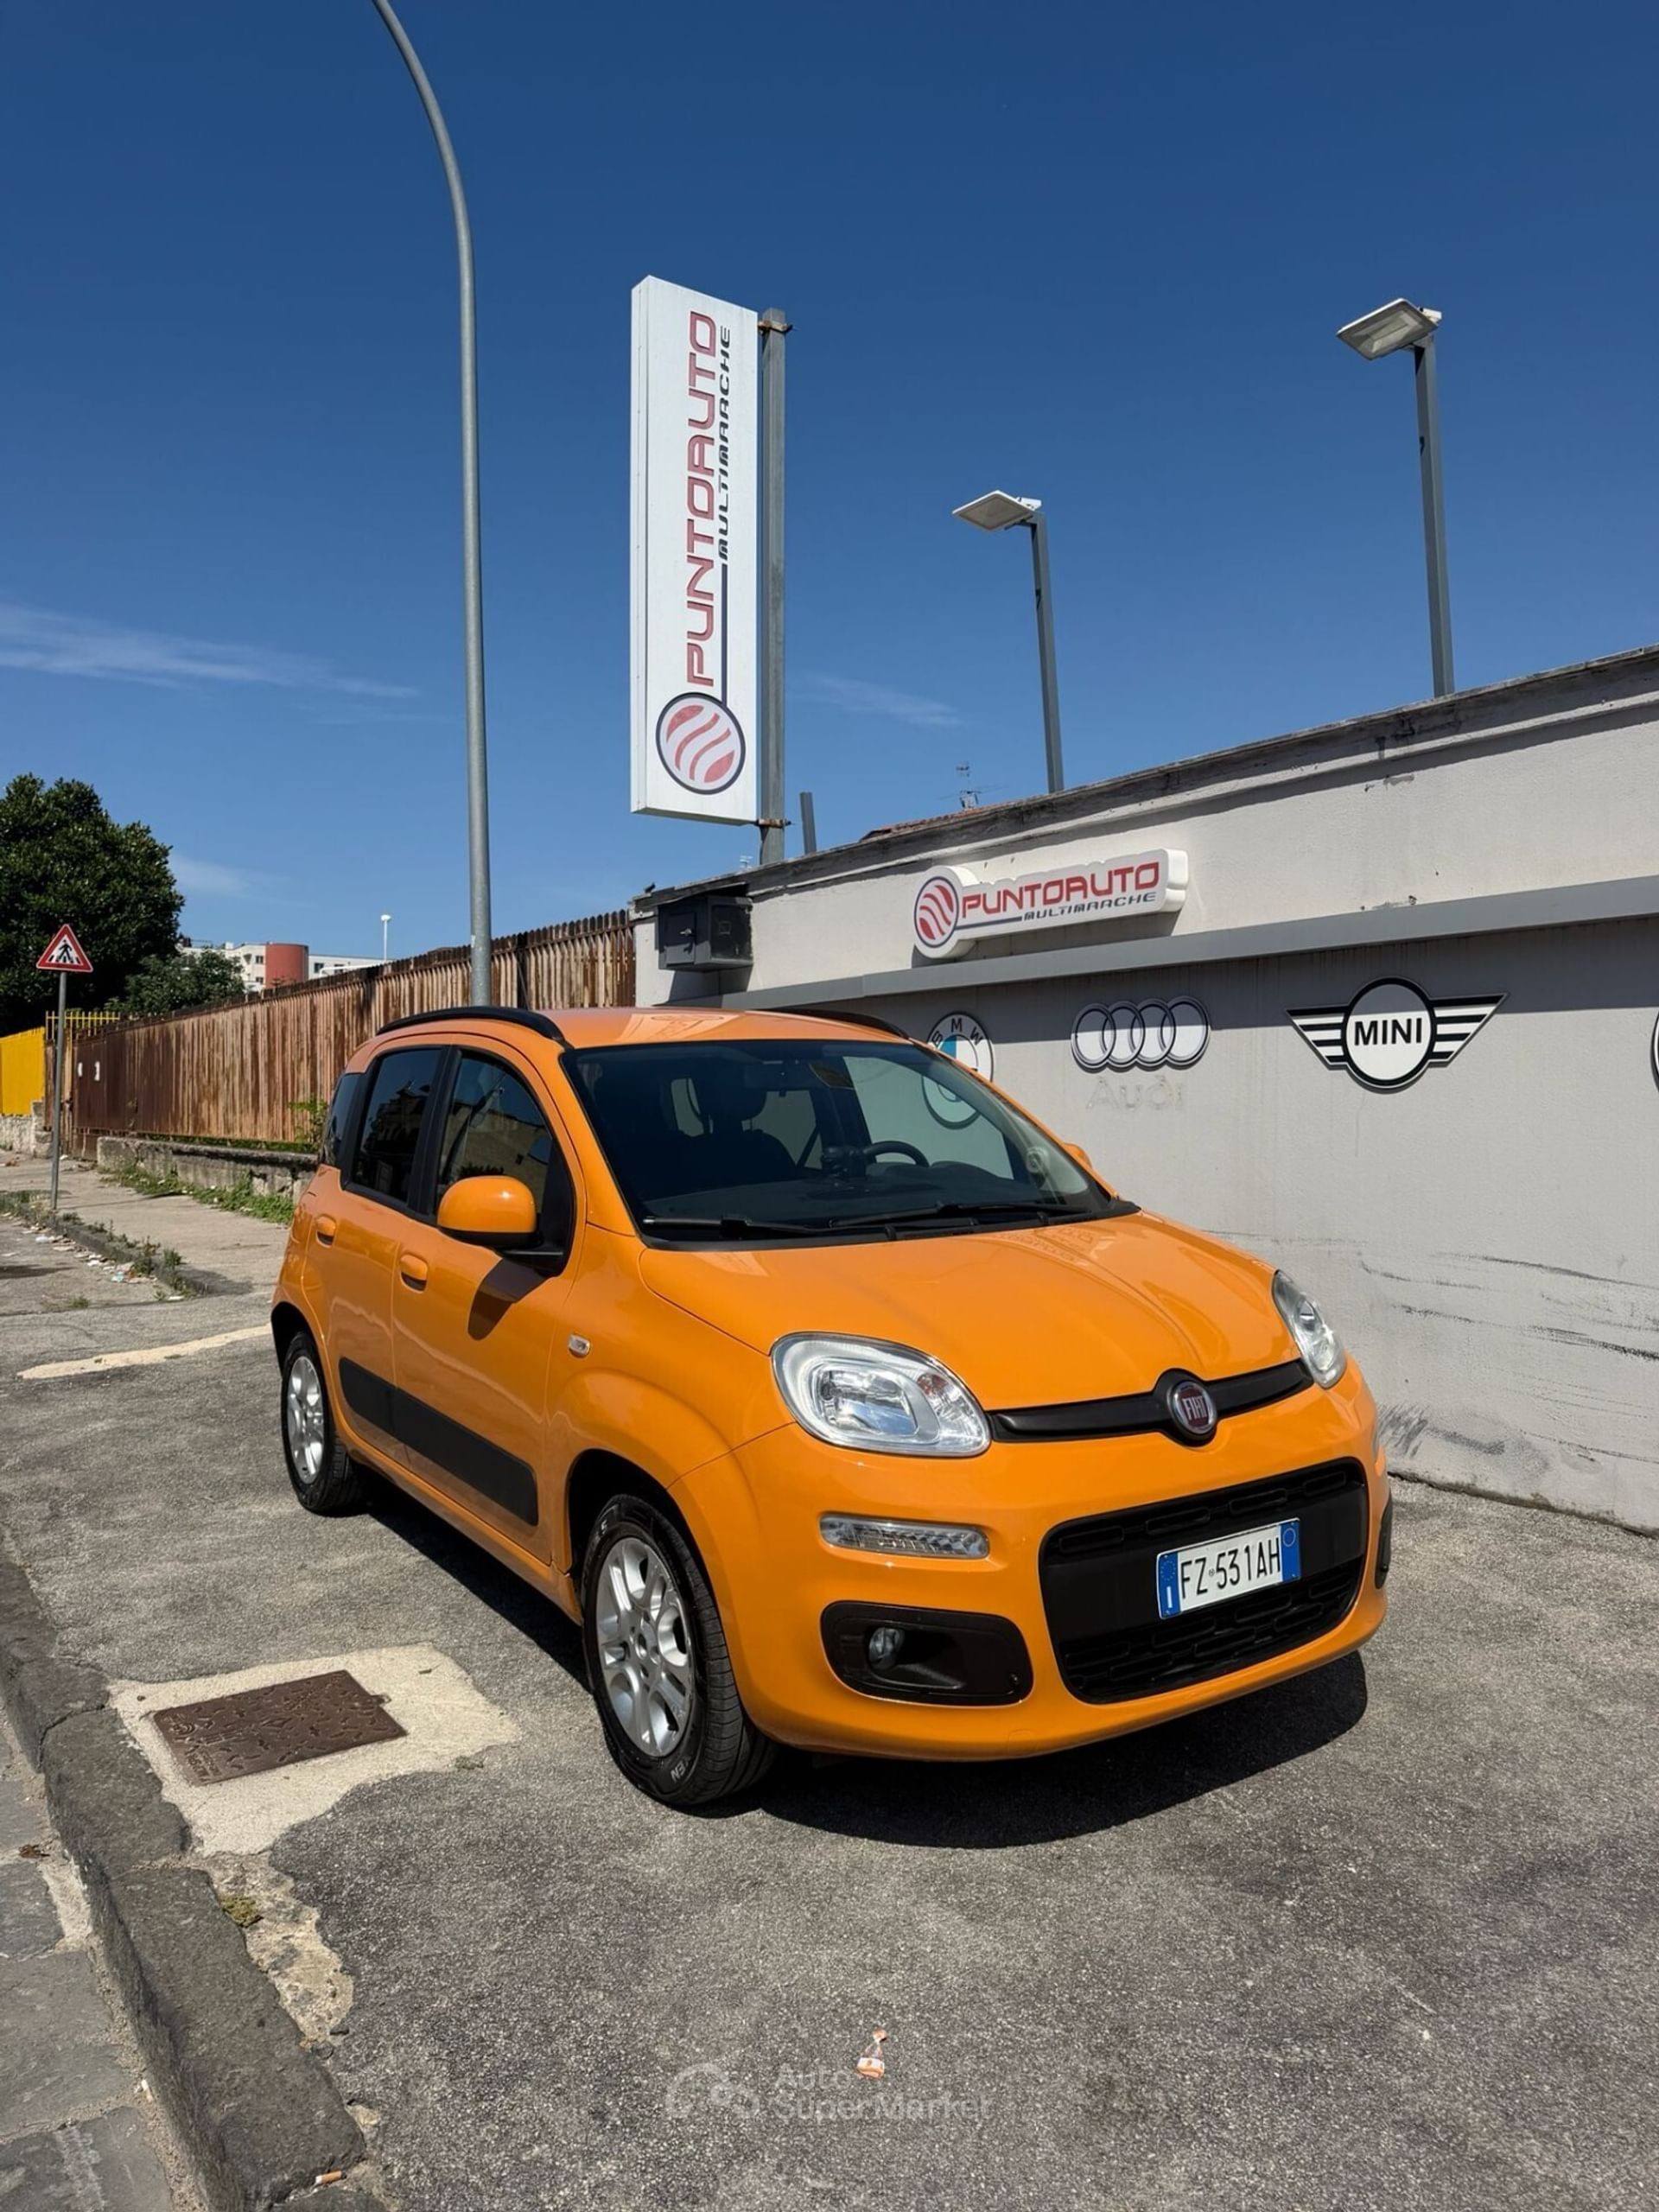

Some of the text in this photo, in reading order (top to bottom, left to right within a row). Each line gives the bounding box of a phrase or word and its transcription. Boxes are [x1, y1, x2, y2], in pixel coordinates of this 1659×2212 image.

[718, 325, 731, 561] MULTIMARCHE
[687, 310, 716, 687] PUNTOAUTO
[962, 861, 1160, 918] PUNTOAUTO
[1023, 891, 1158, 921] MULTIMARCHE
[931, 1017, 984, 1047] BMW
[1354, 1017, 1423, 1046] MINI
[1181, 1395, 1208, 1421] FIAT
